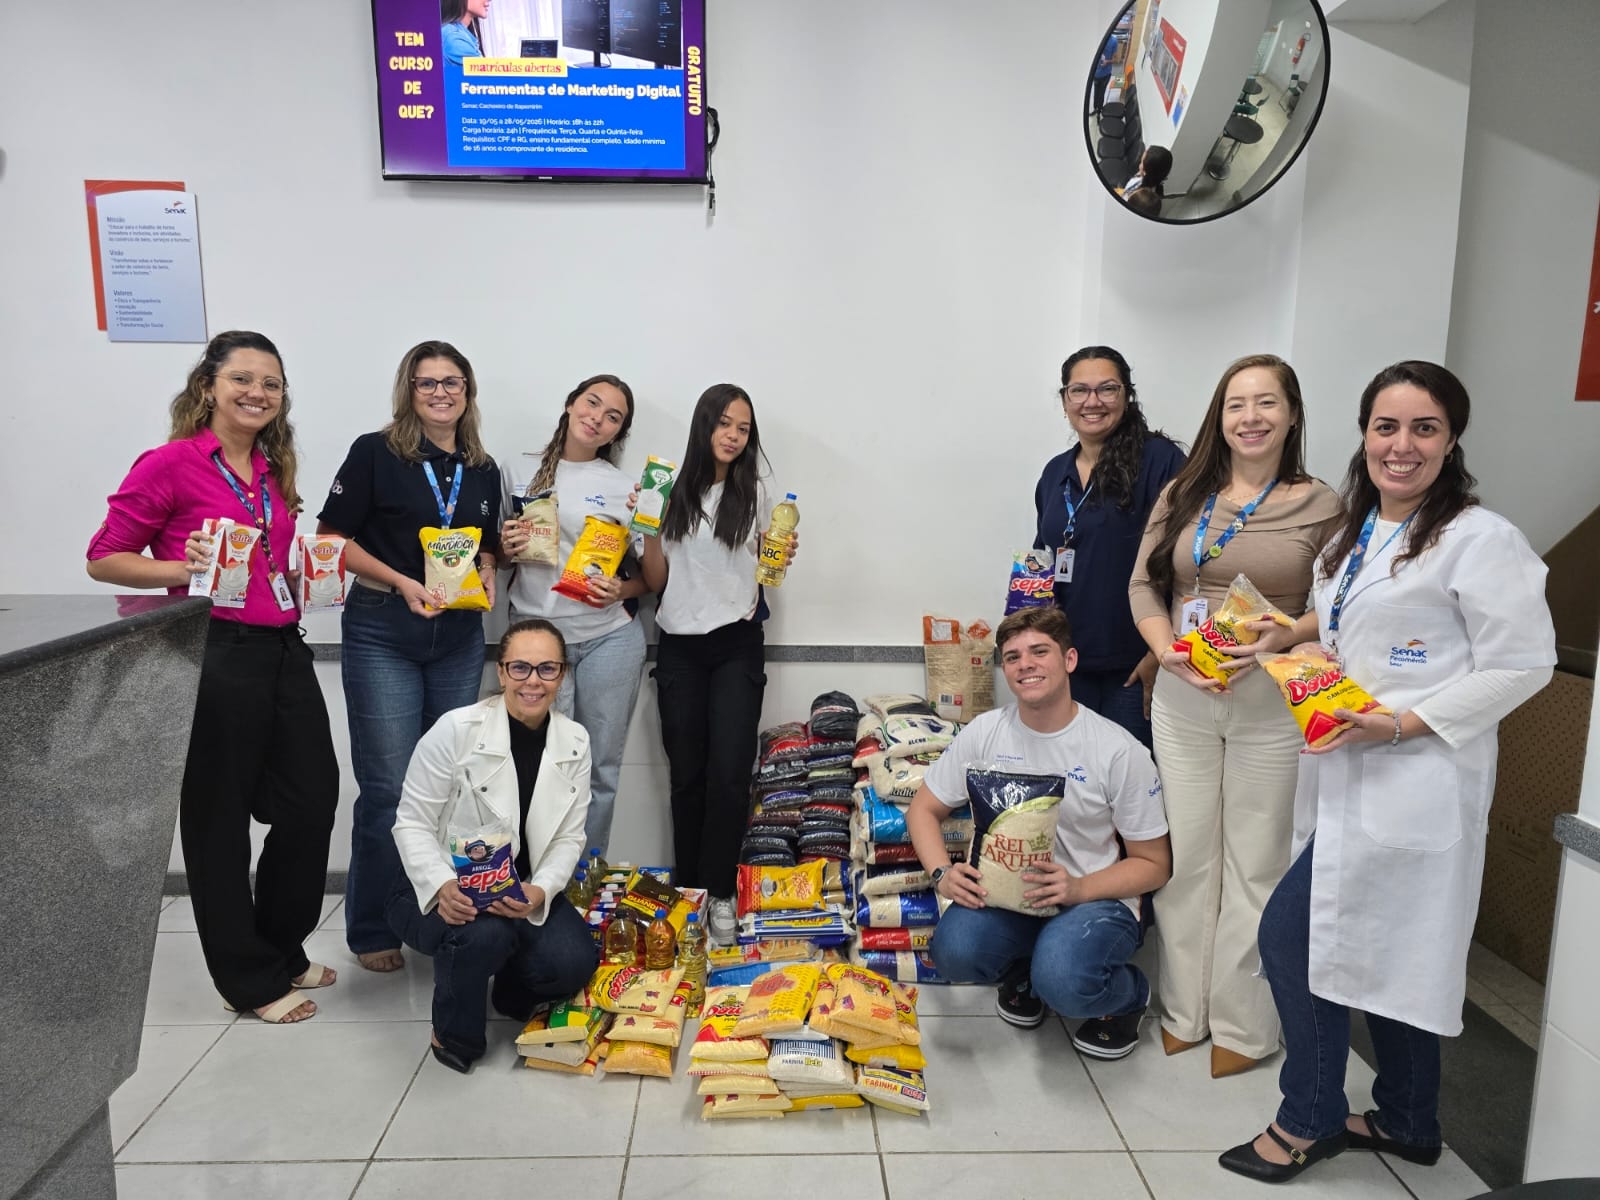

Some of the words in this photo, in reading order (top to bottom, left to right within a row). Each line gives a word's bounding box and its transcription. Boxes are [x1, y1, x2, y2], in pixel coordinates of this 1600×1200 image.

[395, 32, 424, 46] TEM
[389, 56, 433, 71] CURSO
[470, 63, 523, 73] matrículas
[524, 63, 562, 73] abertas
[687, 45, 702, 116] GRATUITO
[403, 81, 422, 95] DE
[461, 83, 545, 96] Ferramentas
[547, 84, 566, 96] de
[567, 84, 635, 100] Marketing
[636, 85, 682, 100] Digital
[398, 105, 434, 119] QUE?
[462, 127, 481, 135] Carga
[606, 128, 643, 136] Quinta-feira
[551, 136, 591, 144] fundamental
[427, 539, 474, 551] MANDIOCA
[762, 546, 782, 561] ABC
[1391, 646, 1428, 658] Senac
[994, 833, 1024, 853] REI
[983, 843, 1052, 873] ARTHUR
[460, 857, 511, 894] sepé
[864, 1078, 899, 1092] FARINHA
